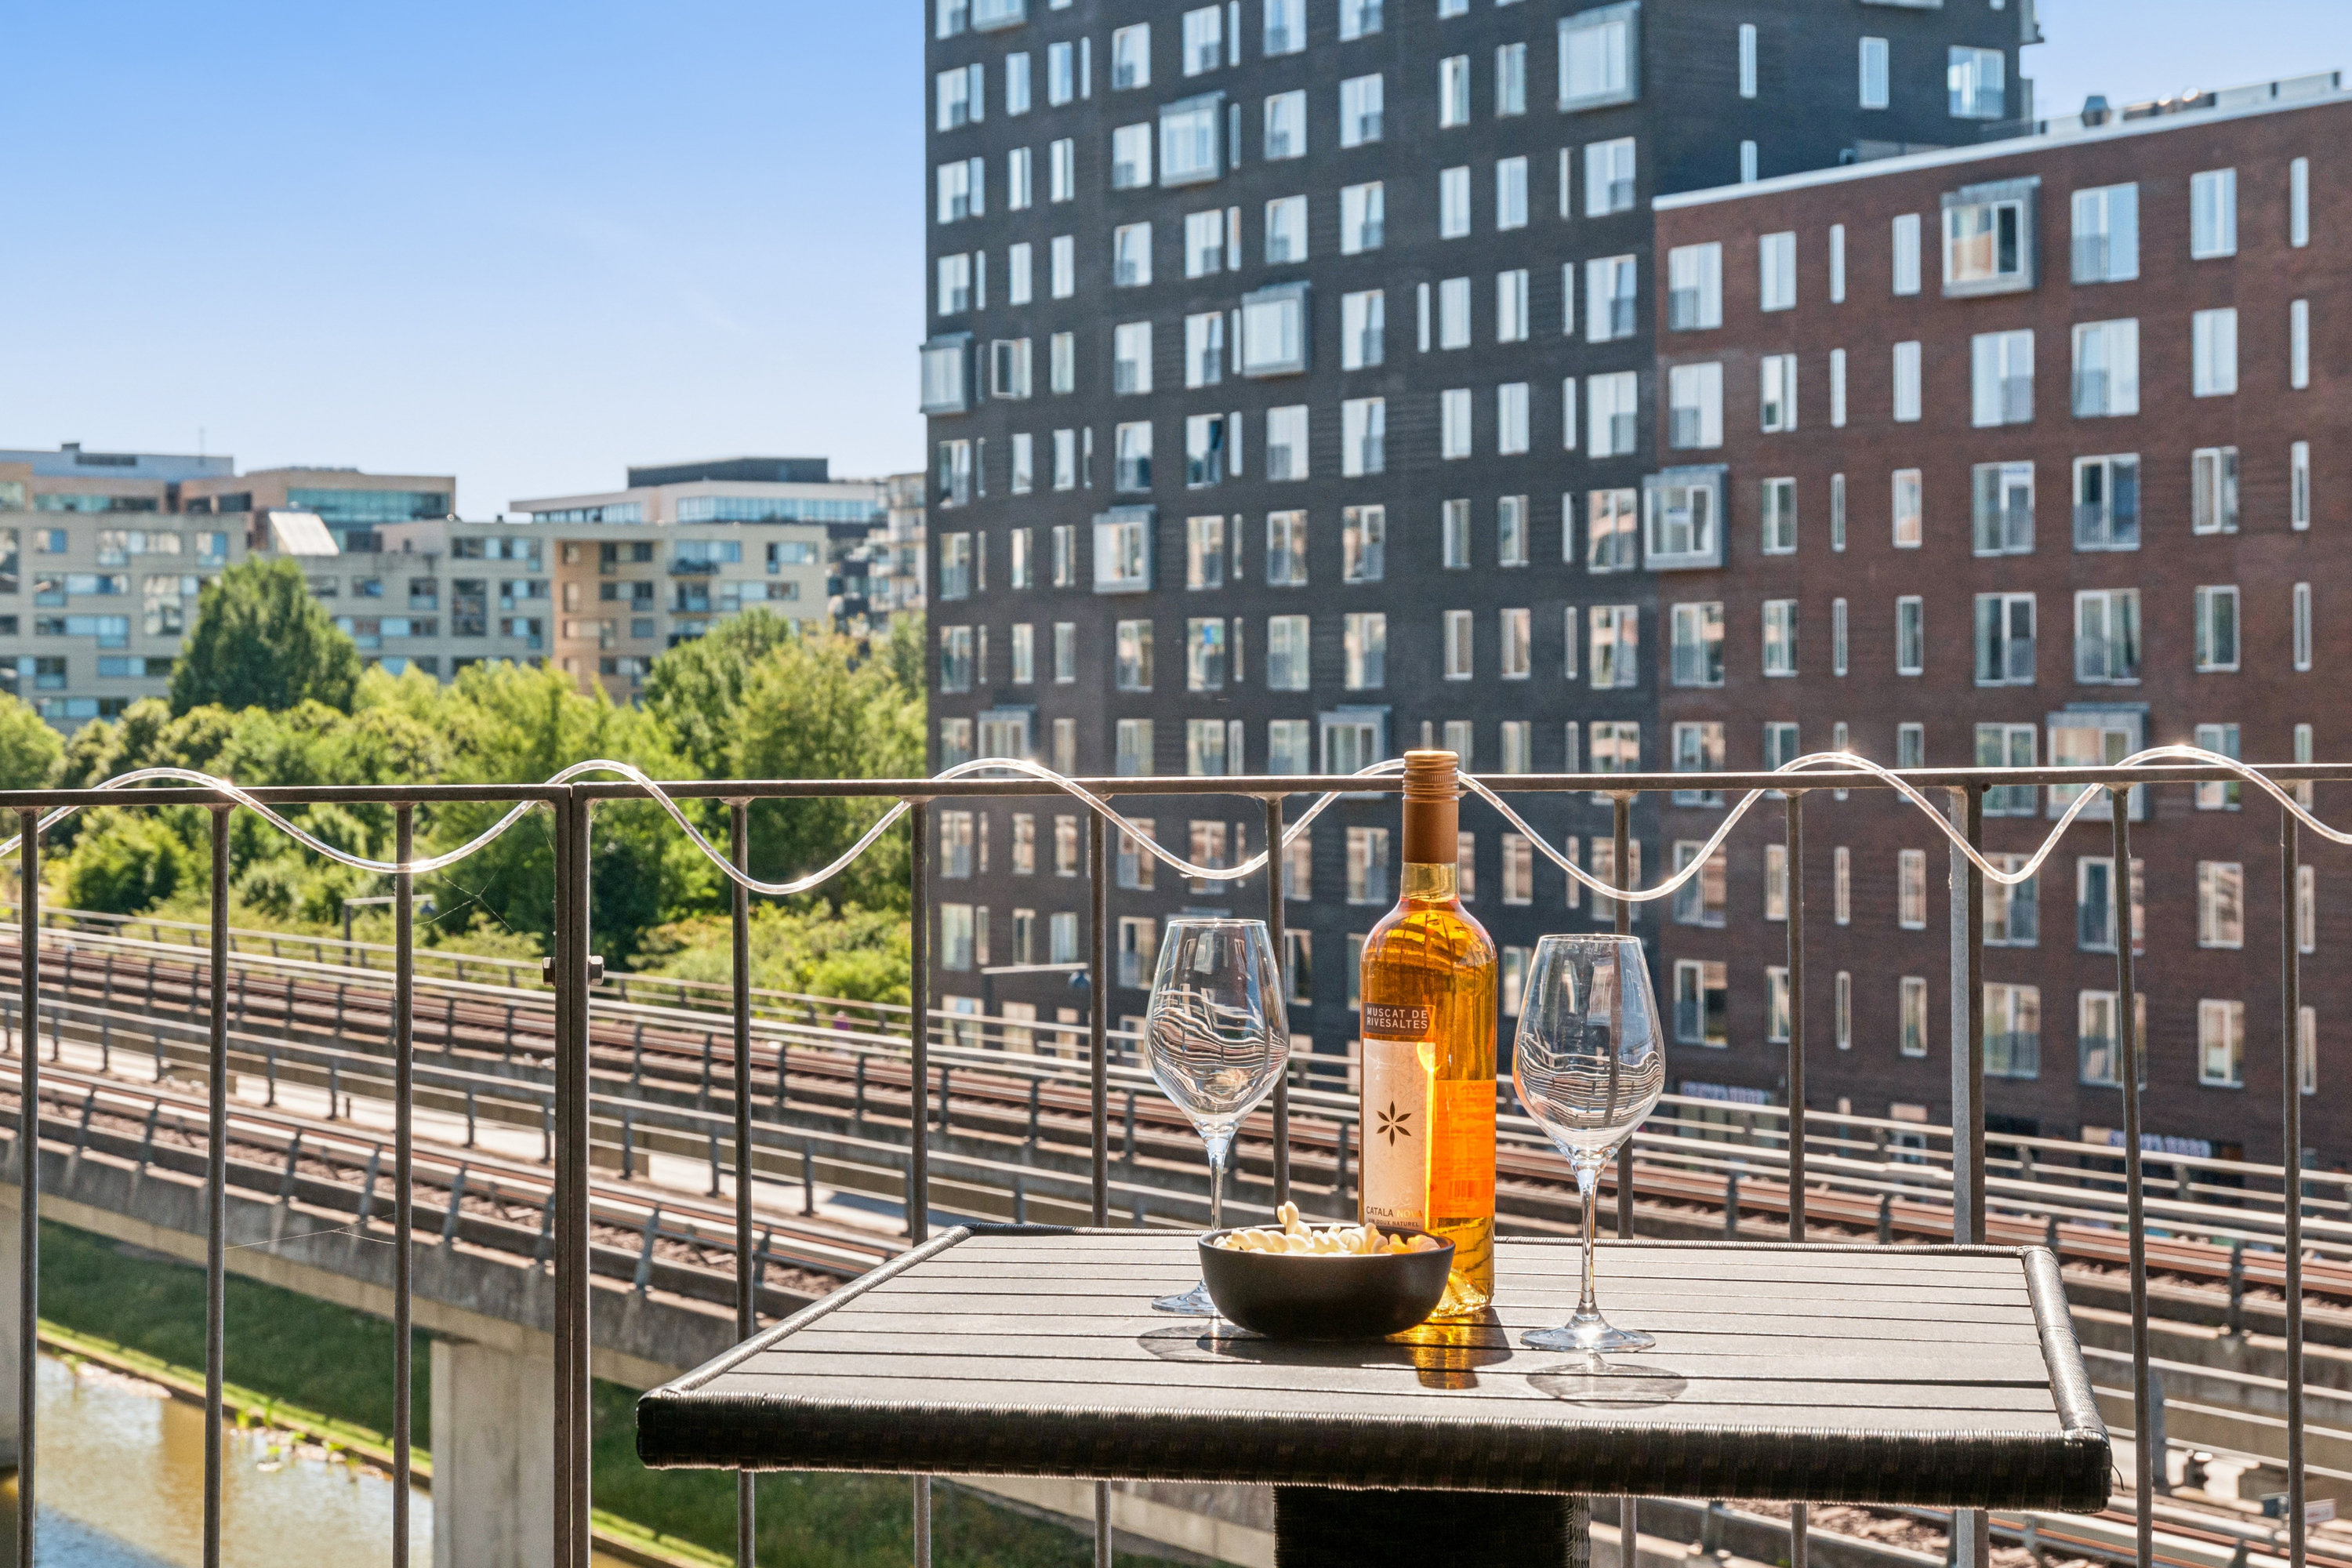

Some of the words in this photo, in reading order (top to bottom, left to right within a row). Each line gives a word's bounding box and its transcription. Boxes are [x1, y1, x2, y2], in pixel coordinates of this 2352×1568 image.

[1367, 1007, 1405, 1018] MUSCAT
[1412, 1010, 1428, 1019] DE
[1367, 1017, 1428, 1029] RIVESALTES
[1366, 1206, 1394, 1218] CATALA
